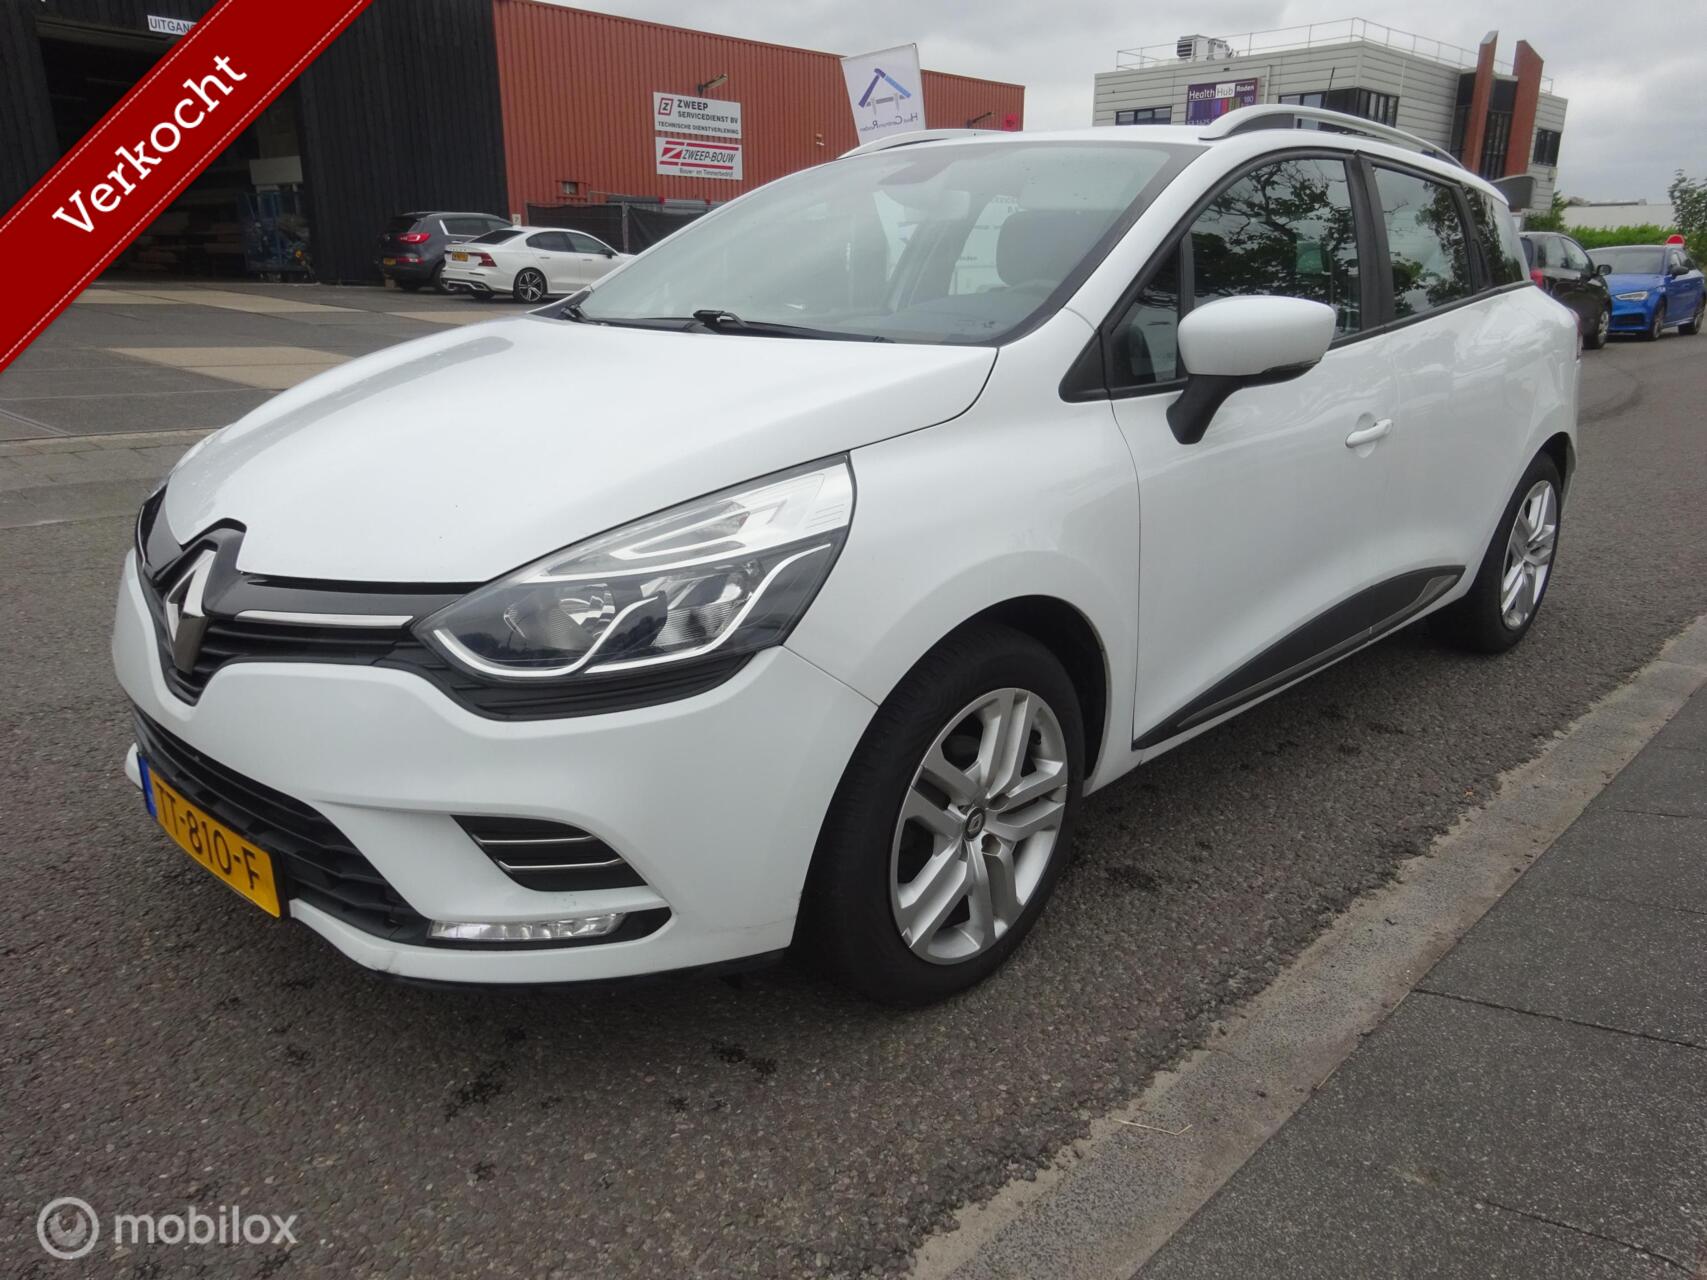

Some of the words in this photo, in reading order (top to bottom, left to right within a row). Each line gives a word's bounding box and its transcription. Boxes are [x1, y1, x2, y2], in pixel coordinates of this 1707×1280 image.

[677, 99, 709, 111] ZWEEP
[678, 111, 728, 122] SERVICEDIENST
[658, 121, 691, 129] TECHNISCHE
[682, 149, 736, 163] ZWEEP-BOUW
[155, 781, 260, 890] TT-810-F
